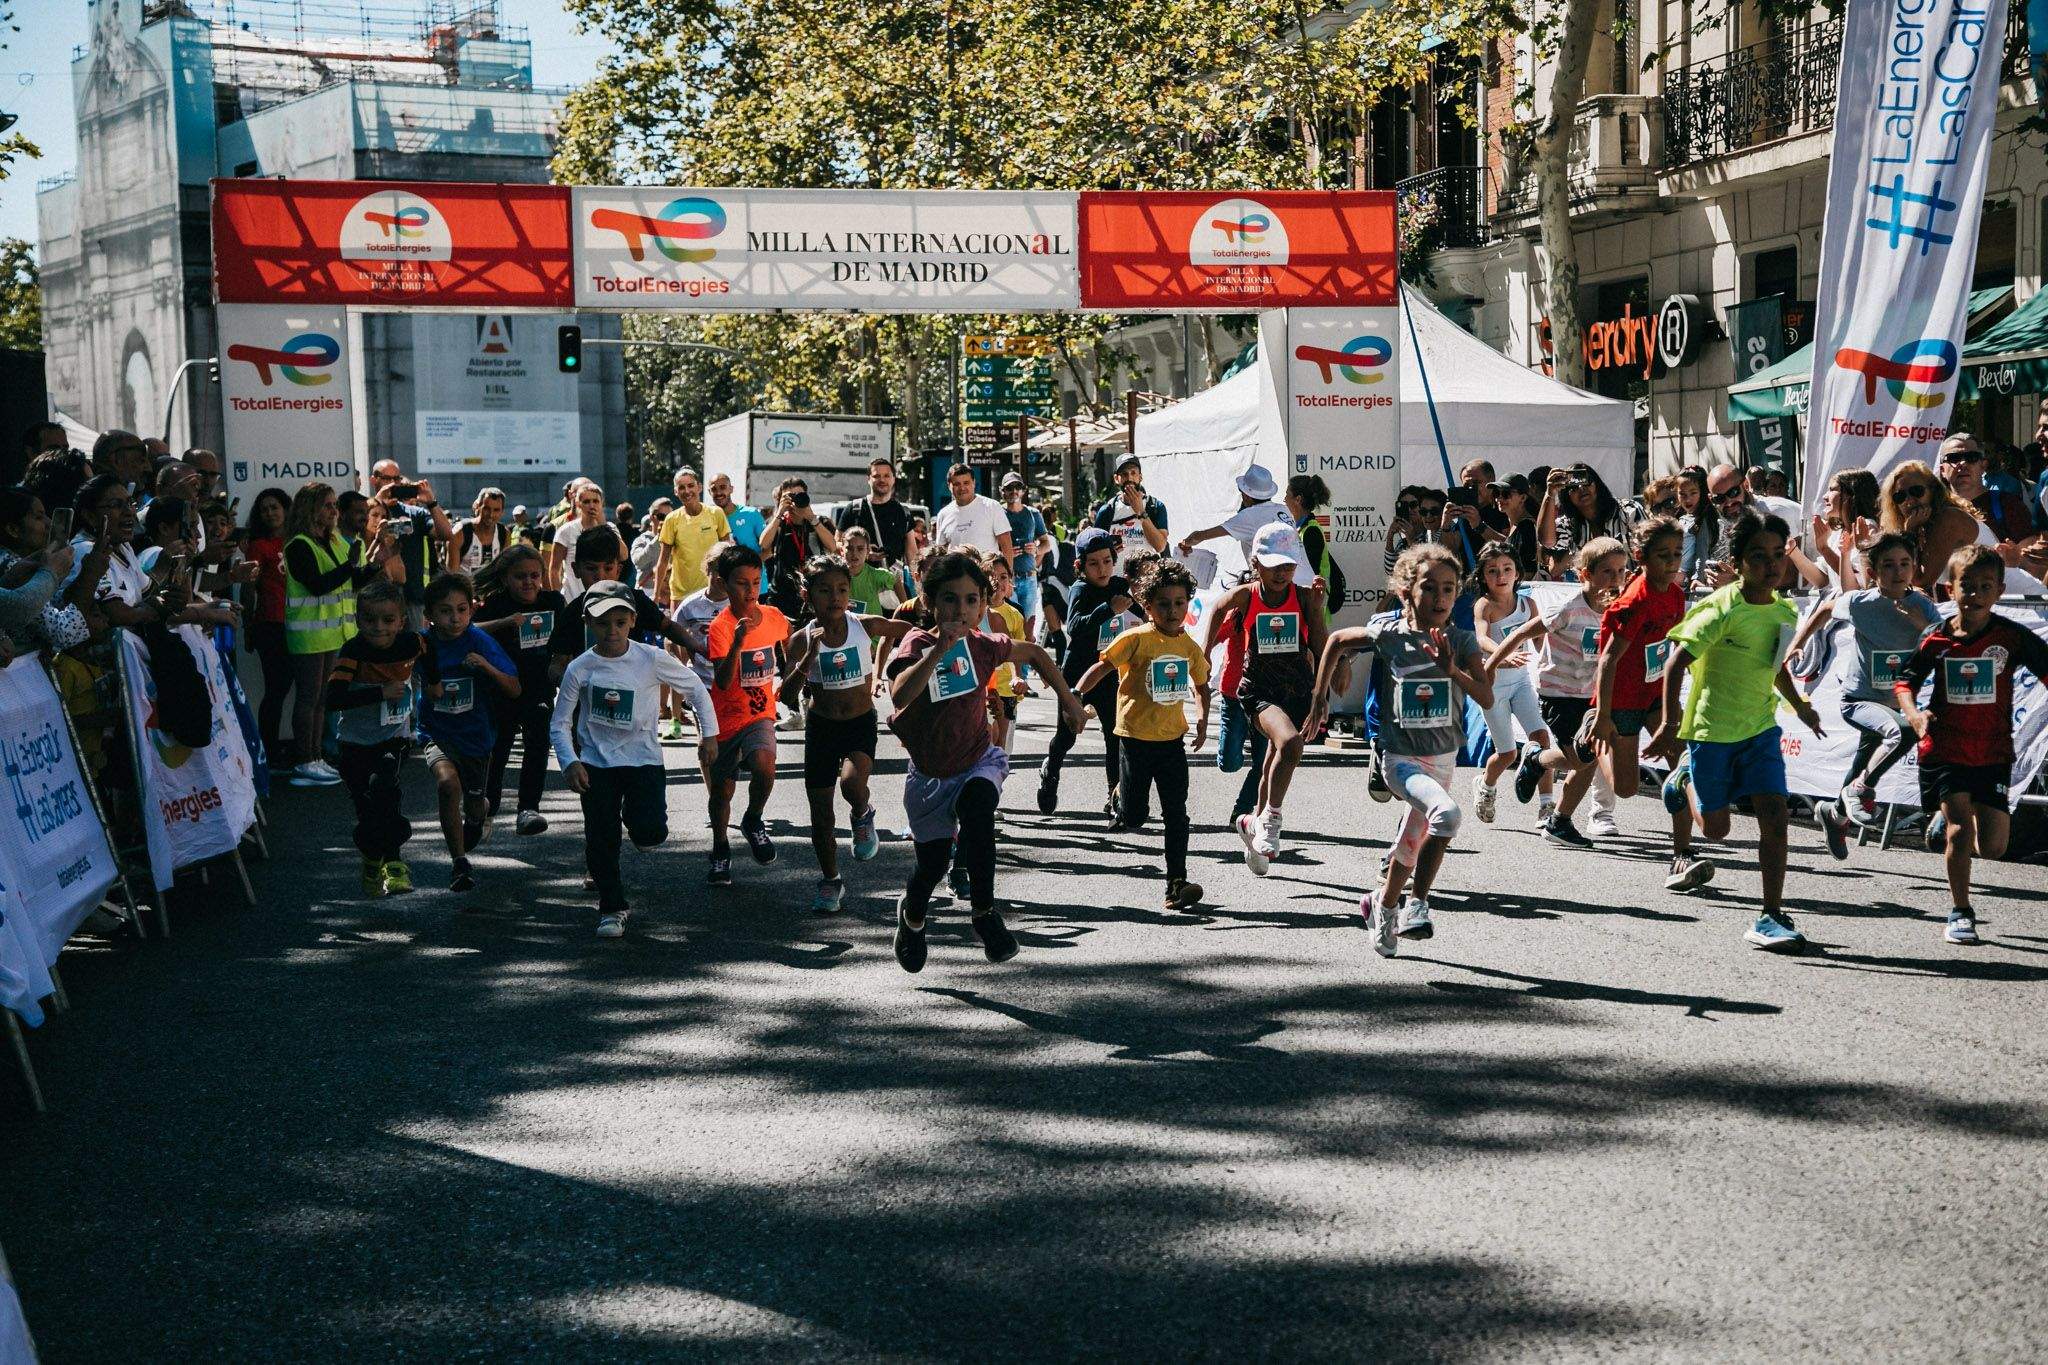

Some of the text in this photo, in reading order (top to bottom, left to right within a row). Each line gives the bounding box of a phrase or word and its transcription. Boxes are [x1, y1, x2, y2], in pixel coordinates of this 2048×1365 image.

[366, 243, 431, 254] TotalEnergies
[747, 231, 838, 253] MILLA
[1212, 249, 1271, 259] TotalEnergies
[382, 262, 413, 271] MILLA
[831, 261, 988, 283] DE MADRID
[1226, 267, 1254, 275] MILLA
[371, 282, 426, 290] DE MADRID
[592, 276, 729, 297] TotalEnergies
[1216, 285, 1265, 293] DE MADRID
[468, 357, 521, 368] Abierto por
[466, 368, 526, 377] Restauración
[1977, 364, 2016, 394] Bexley
[229, 396, 343, 413] TotalEnergies
[1296, 394, 1393, 410] TotalEnergies
[967, 428, 996, 436] Palacio
[1831, 418, 1946, 444] TotalEnergies
[775, 436, 794, 450] FJS
[1320, 455, 1396, 470] MADRID
[262, 461, 350, 479] MADRID
[1335, 514, 1386, 527] MILLA
[1335, 530, 1388, 543] URBAN
